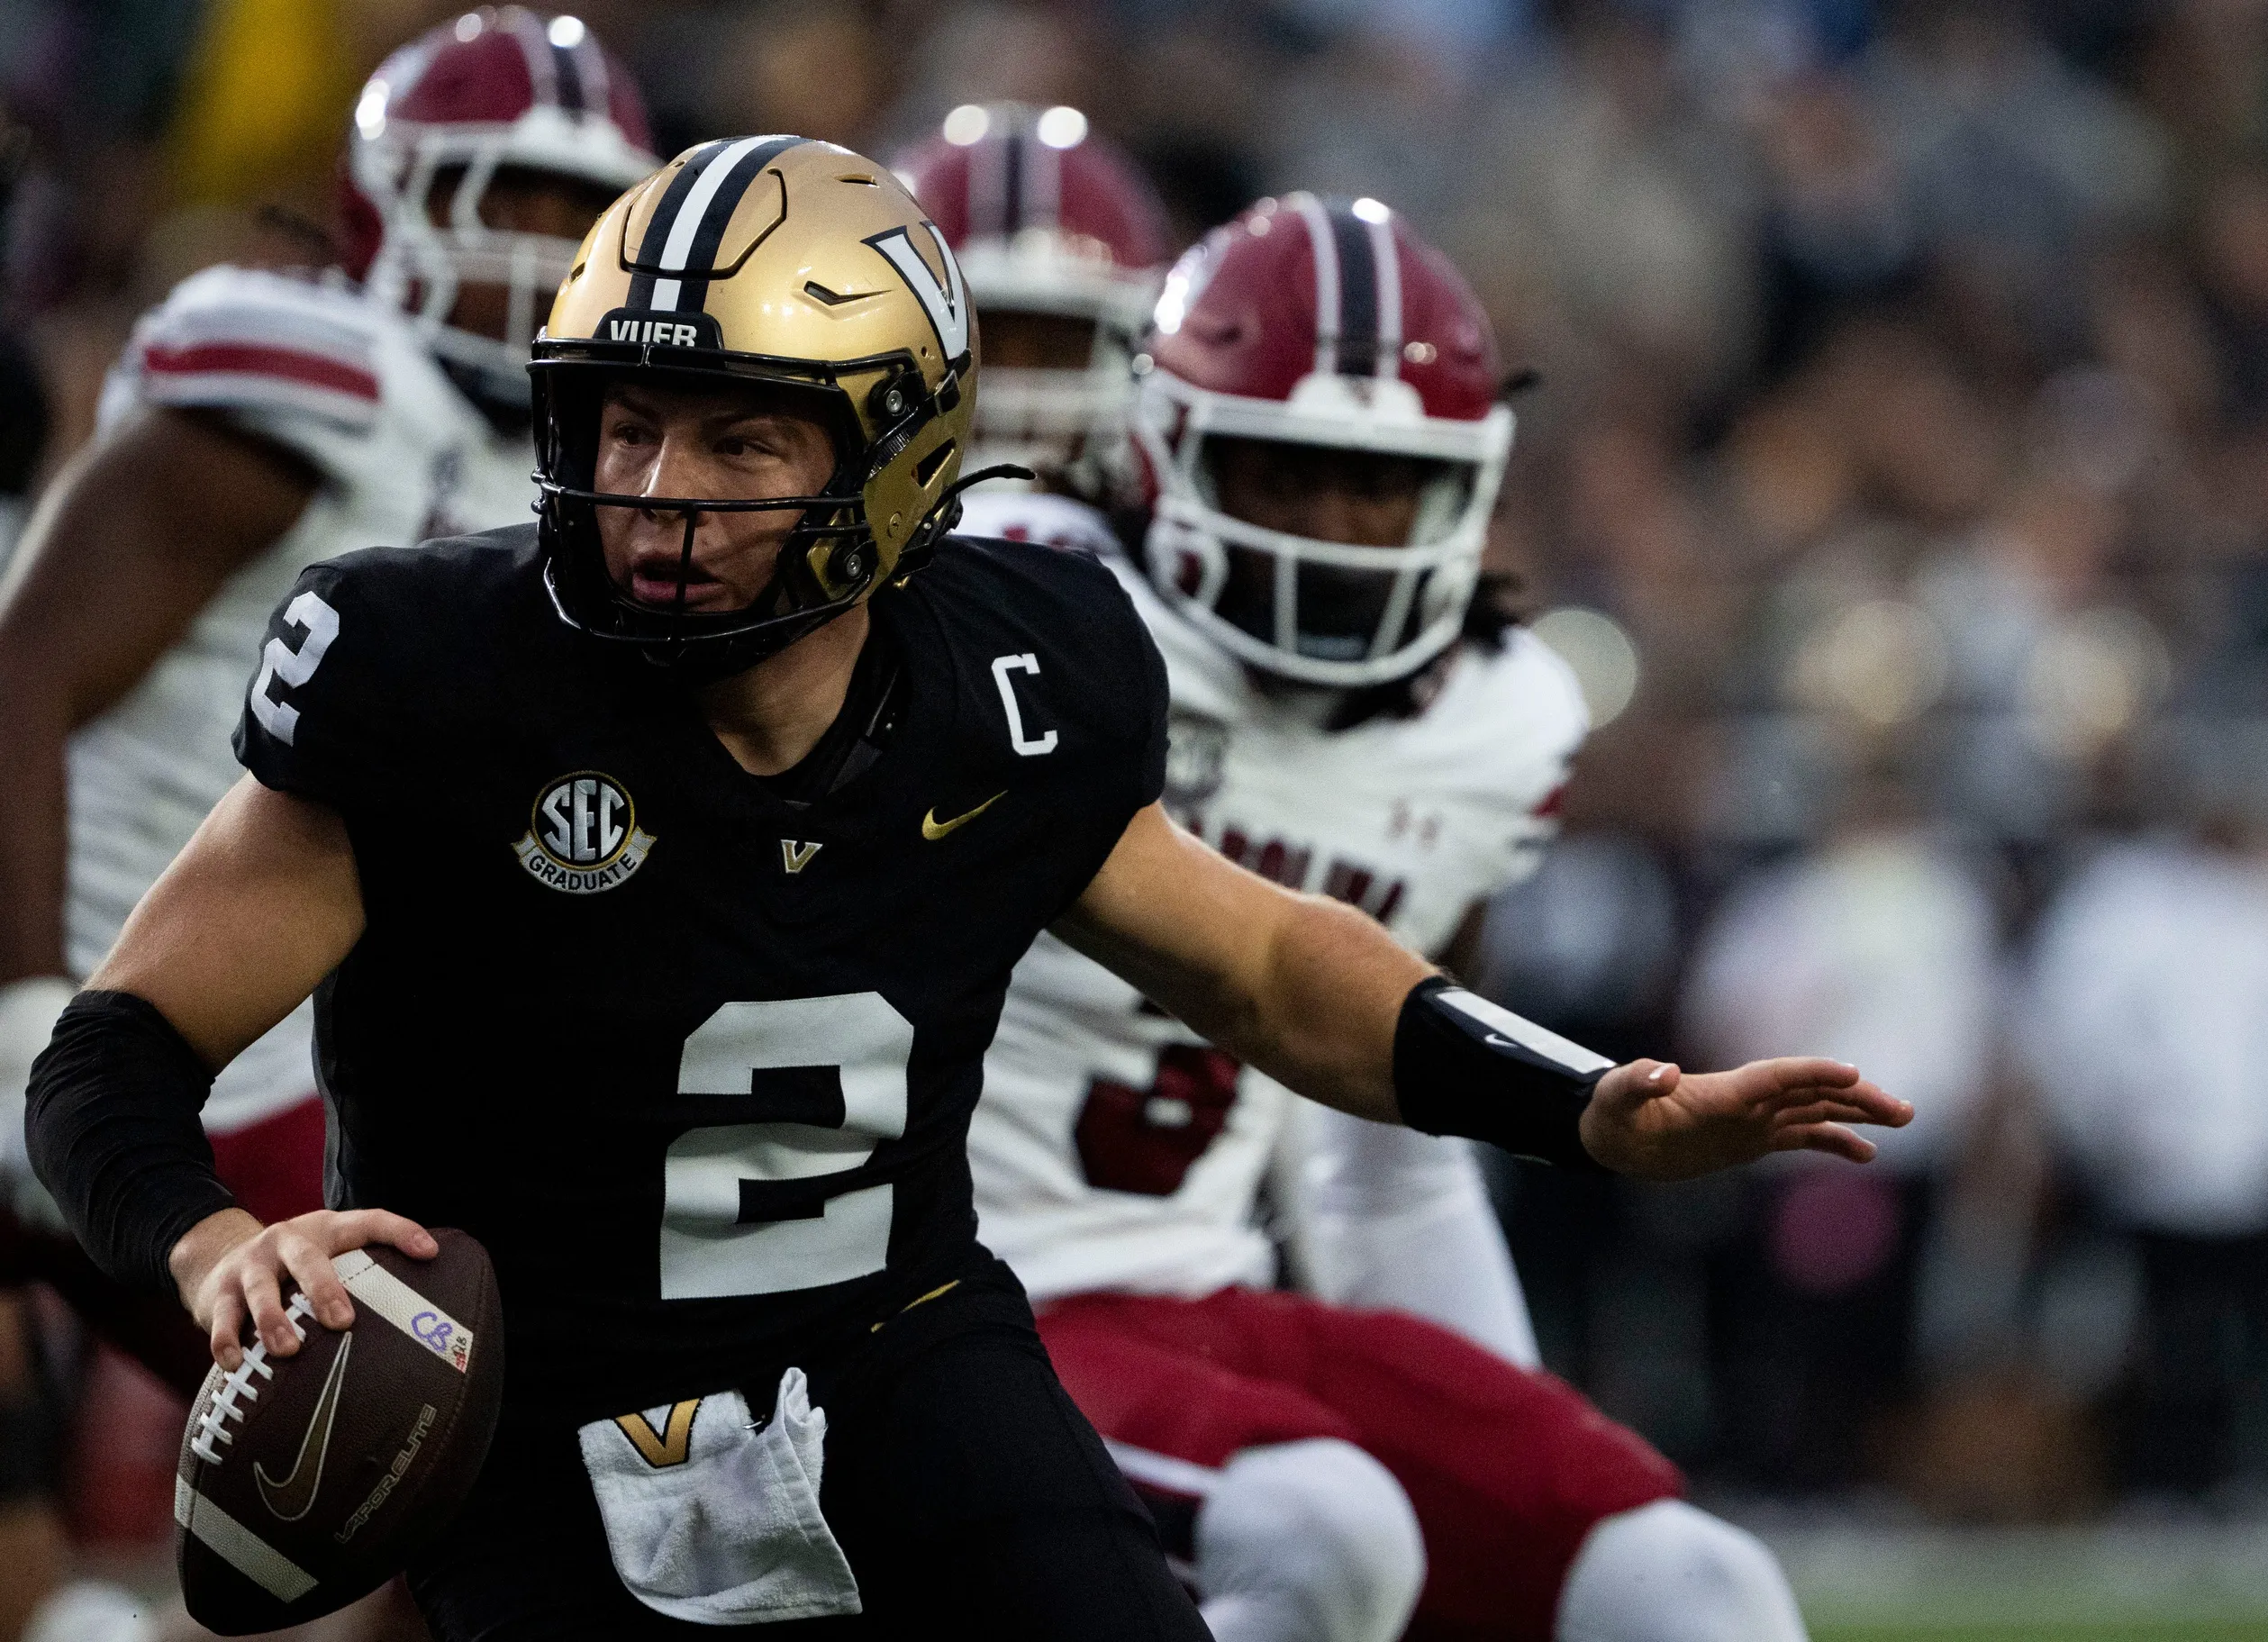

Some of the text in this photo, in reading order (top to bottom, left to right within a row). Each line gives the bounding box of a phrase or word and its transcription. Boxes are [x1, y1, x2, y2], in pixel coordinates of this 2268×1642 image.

[250, 591, 340, 748] 2
[991, 653, 1058, 756] C
[541, 779, 625, 861] SEC
[780, 839, 823, 875] V
[529, 853, 637, 892] GRADUATE
[660, 991, 914, 1300] 2
[333, 1402, 439, 1545] VAPOR ELITE
[614, 1398, 702, 1469] V
